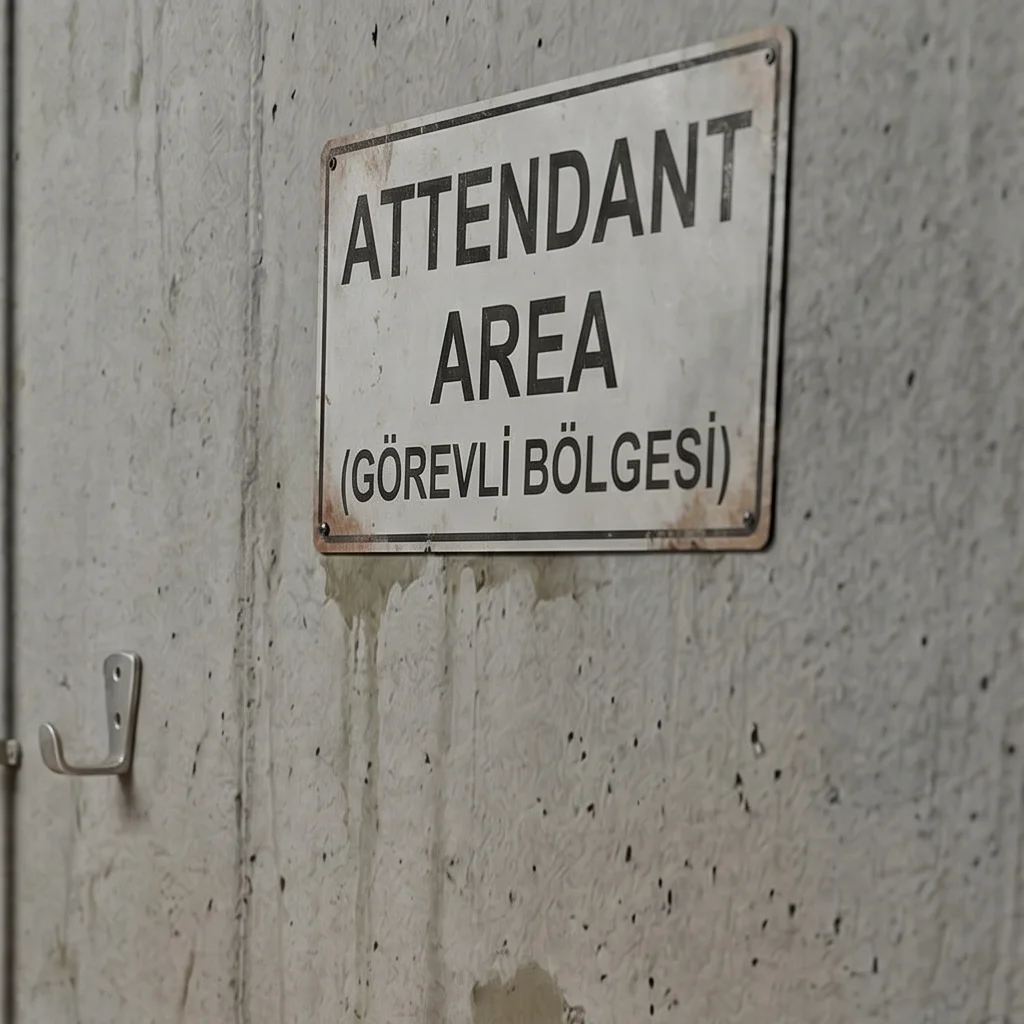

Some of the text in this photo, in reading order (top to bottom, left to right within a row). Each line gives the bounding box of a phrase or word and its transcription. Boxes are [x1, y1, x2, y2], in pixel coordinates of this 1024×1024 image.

[341, 110, 753, 286] ATTENDANT
[430, 290, 618, 405] AREA
[340, 411, 732, 516] (GÖREVLİ BÖLGESİ)
